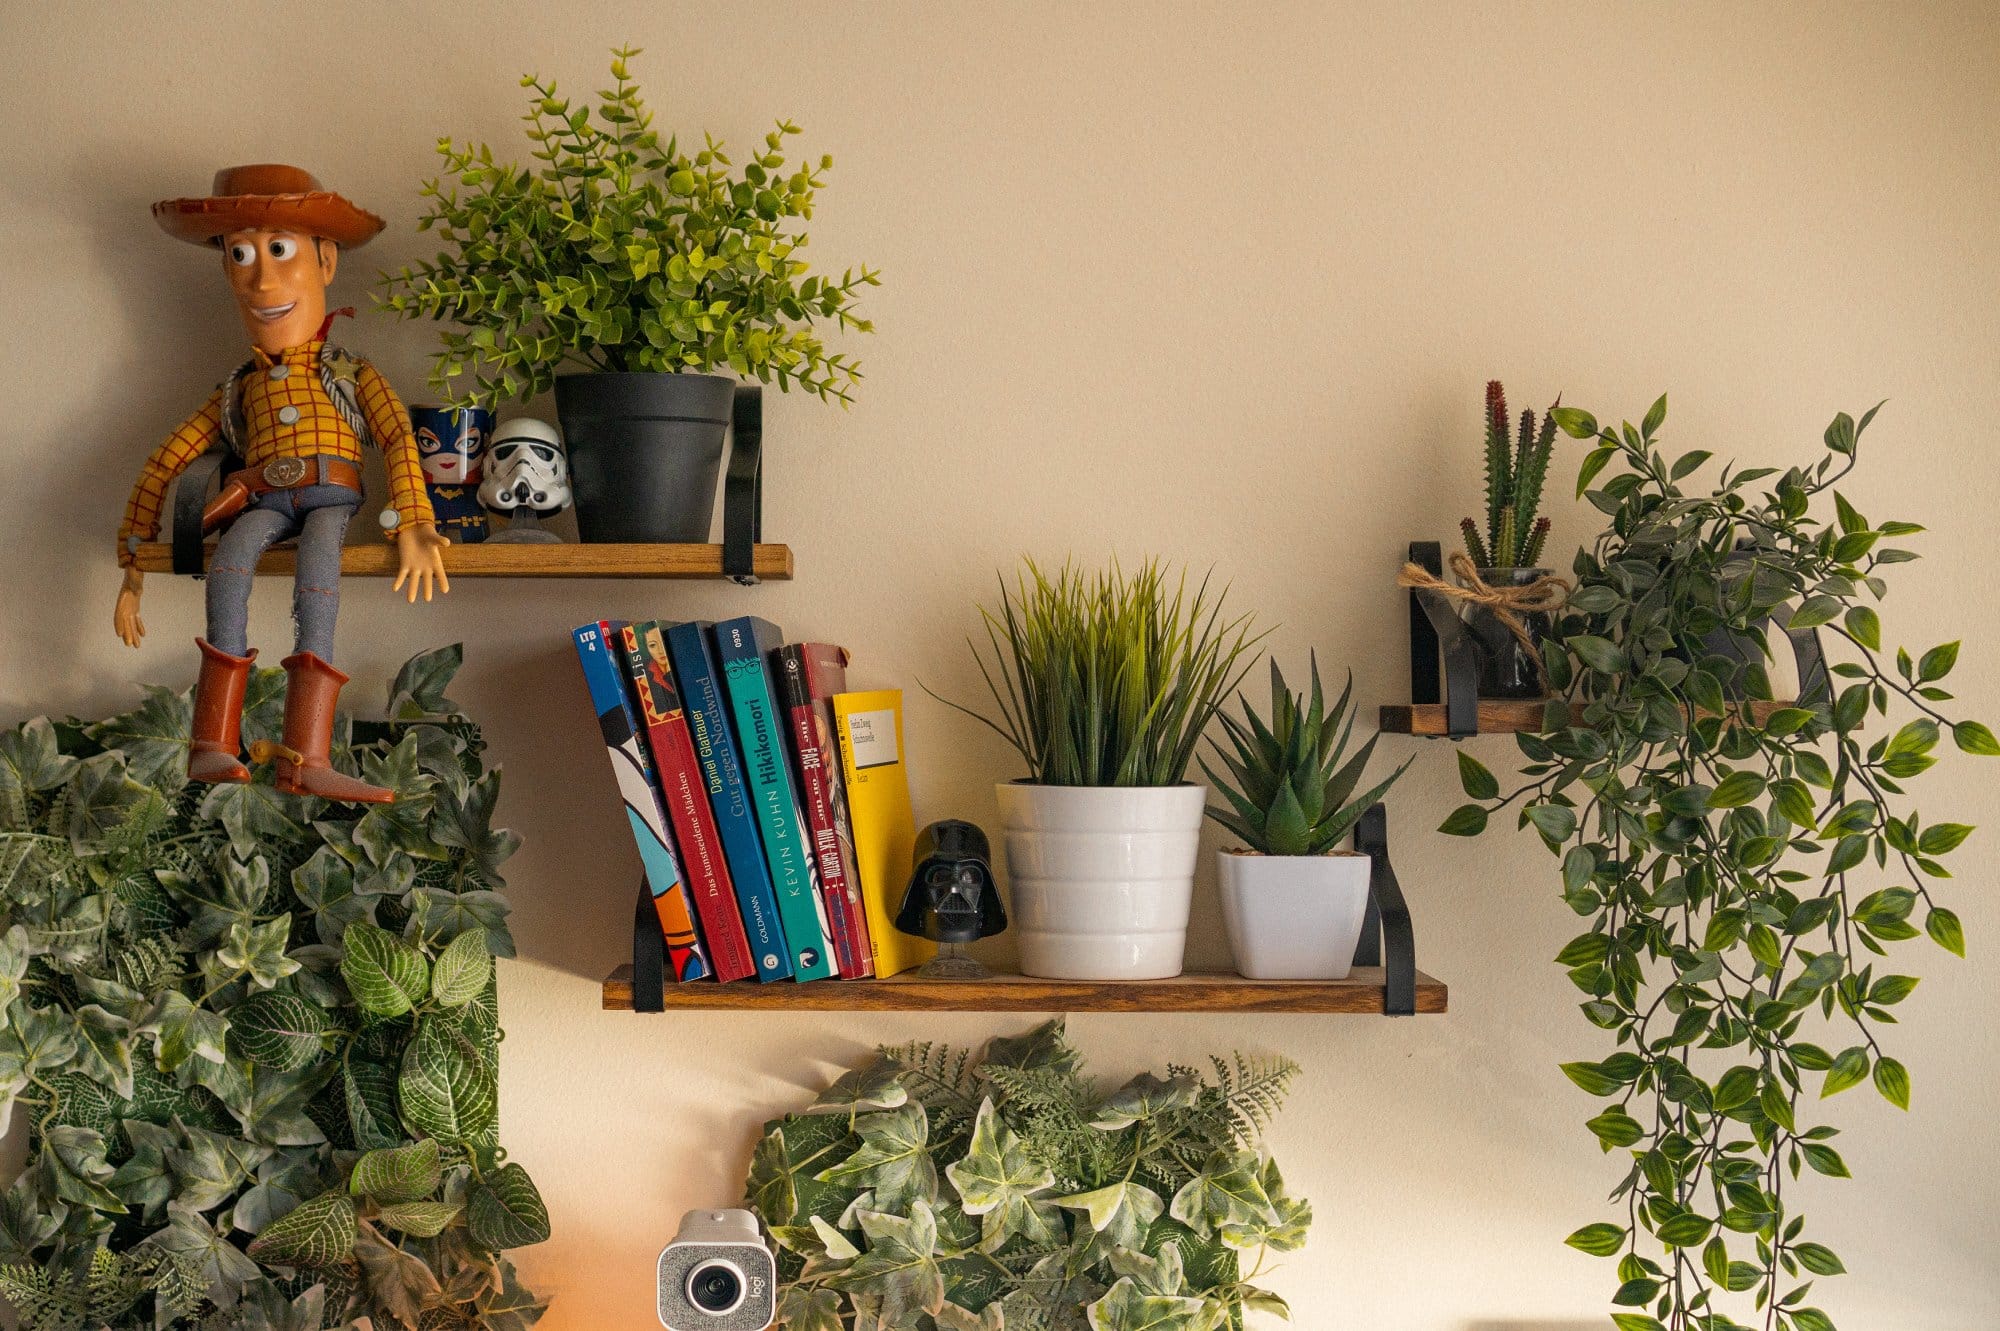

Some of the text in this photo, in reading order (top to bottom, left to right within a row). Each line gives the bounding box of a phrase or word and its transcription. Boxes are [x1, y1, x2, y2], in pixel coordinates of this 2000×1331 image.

[579, 630, 597, 644] LTB
[588, 642, 596, 652] 4
[731, 628, 742, 648] 0930
[630, 647, 646, 680] List
[744, 698, 778, 786] Hikikomori
[801, 721, 809, 743] the
[692, 709, 723, 794] Daniel Glattauer
[696, 675, 745, 817] Gut gegen Nordwind
[801, 747, 821, 770] FACE
[812, 778, 820, 796] on
[816, 799, 825, 822] the
[679, 771, 719, 897] Das kunstseidene Mädchen
[766, 789, 800, 897] KEVIN KUHN
[816, 828, 837, 851] MILK
[821, 852, 842, 879] CARTON
[750, 895, 769, 944] GOLDMANN
[750, 1276, 766, 1297] logi
